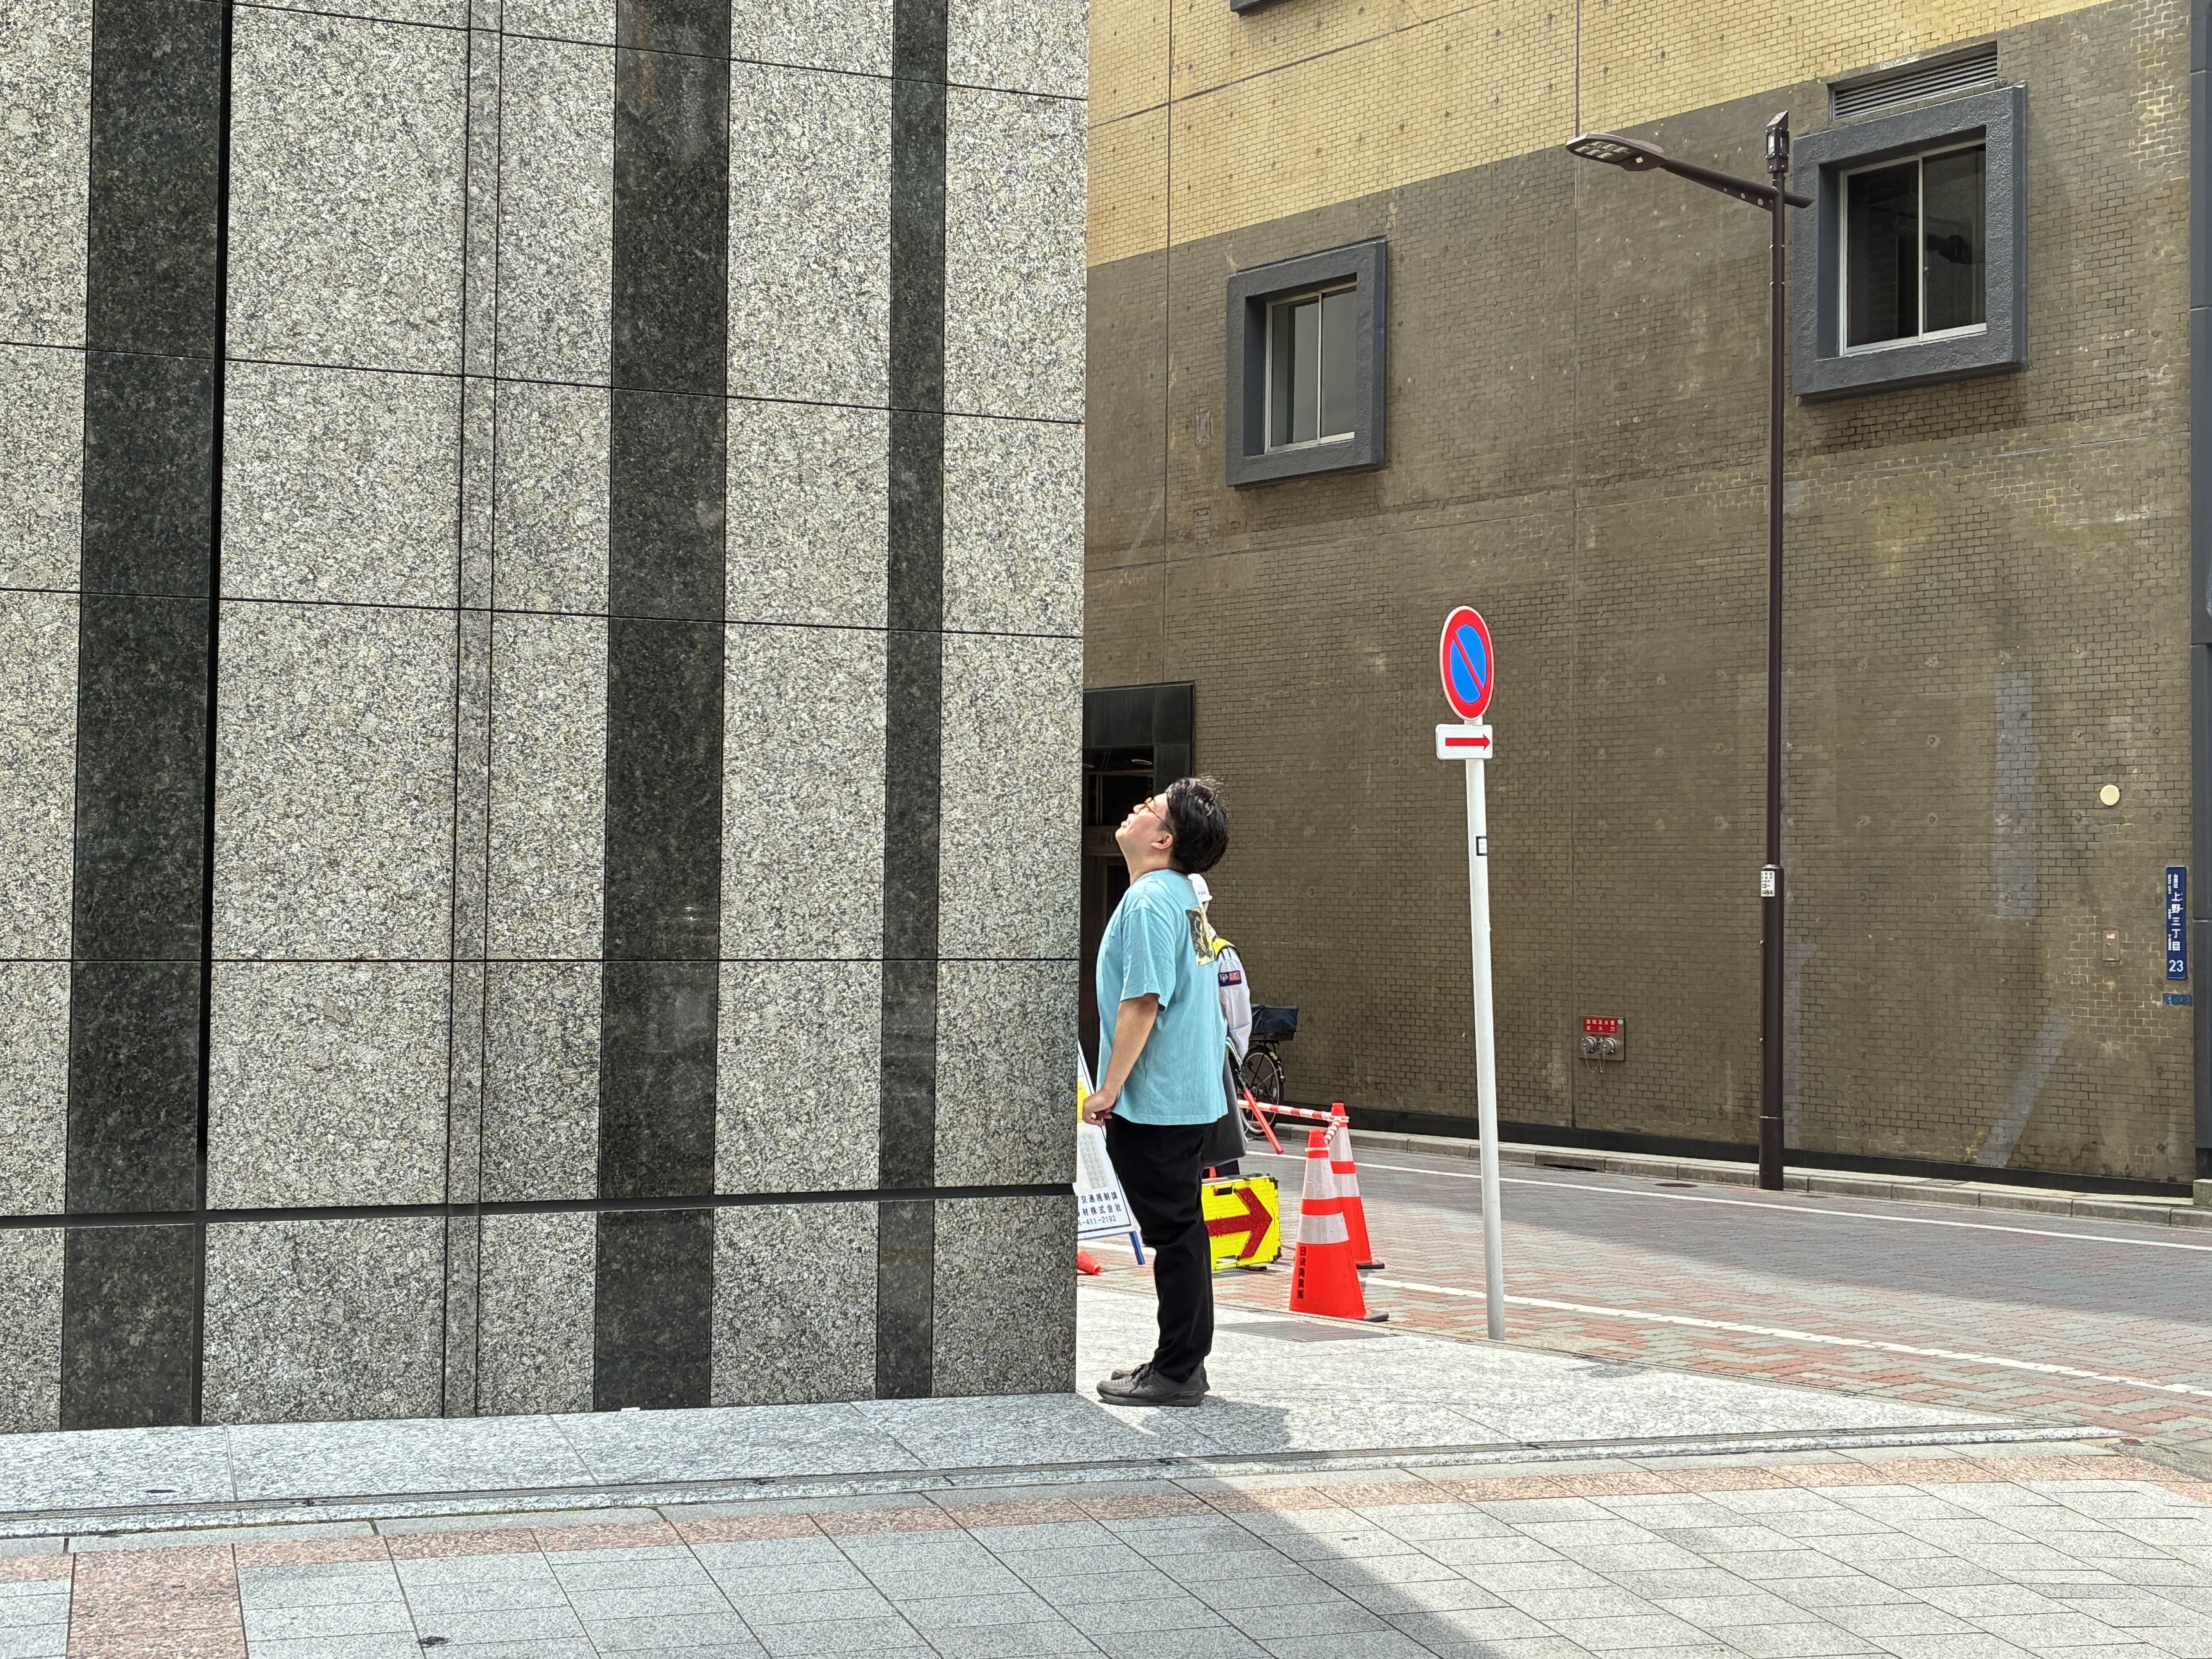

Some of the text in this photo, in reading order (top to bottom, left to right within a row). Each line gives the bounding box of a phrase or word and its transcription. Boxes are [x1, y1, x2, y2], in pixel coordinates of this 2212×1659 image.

[2171, 892, 2181, 951] 上野三丁目
[2169, 960, 2183, 972] 23
[1078, 1203, 1122, 1217] 材株式会社
